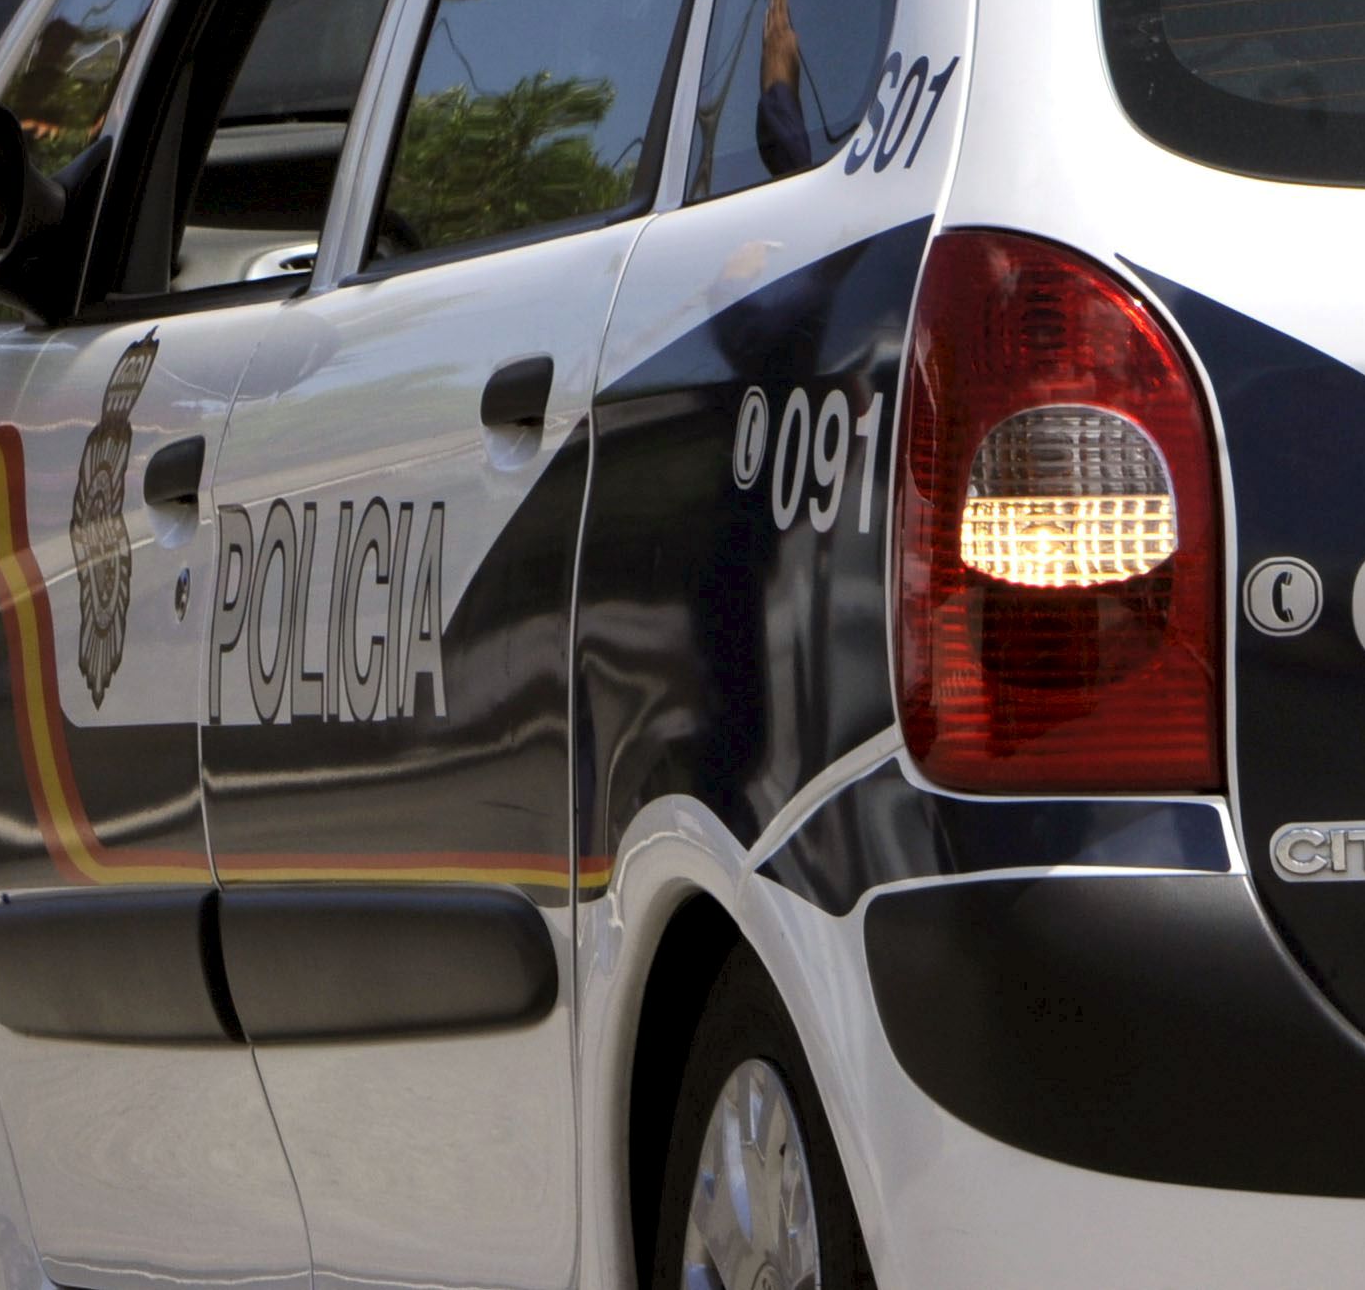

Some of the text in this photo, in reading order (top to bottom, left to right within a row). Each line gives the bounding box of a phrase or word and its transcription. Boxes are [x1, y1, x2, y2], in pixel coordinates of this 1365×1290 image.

[843, 50, 961, 176] S01
[772, 388, 883, 534] 091
[208, 495, 448, 726] POLICIA
